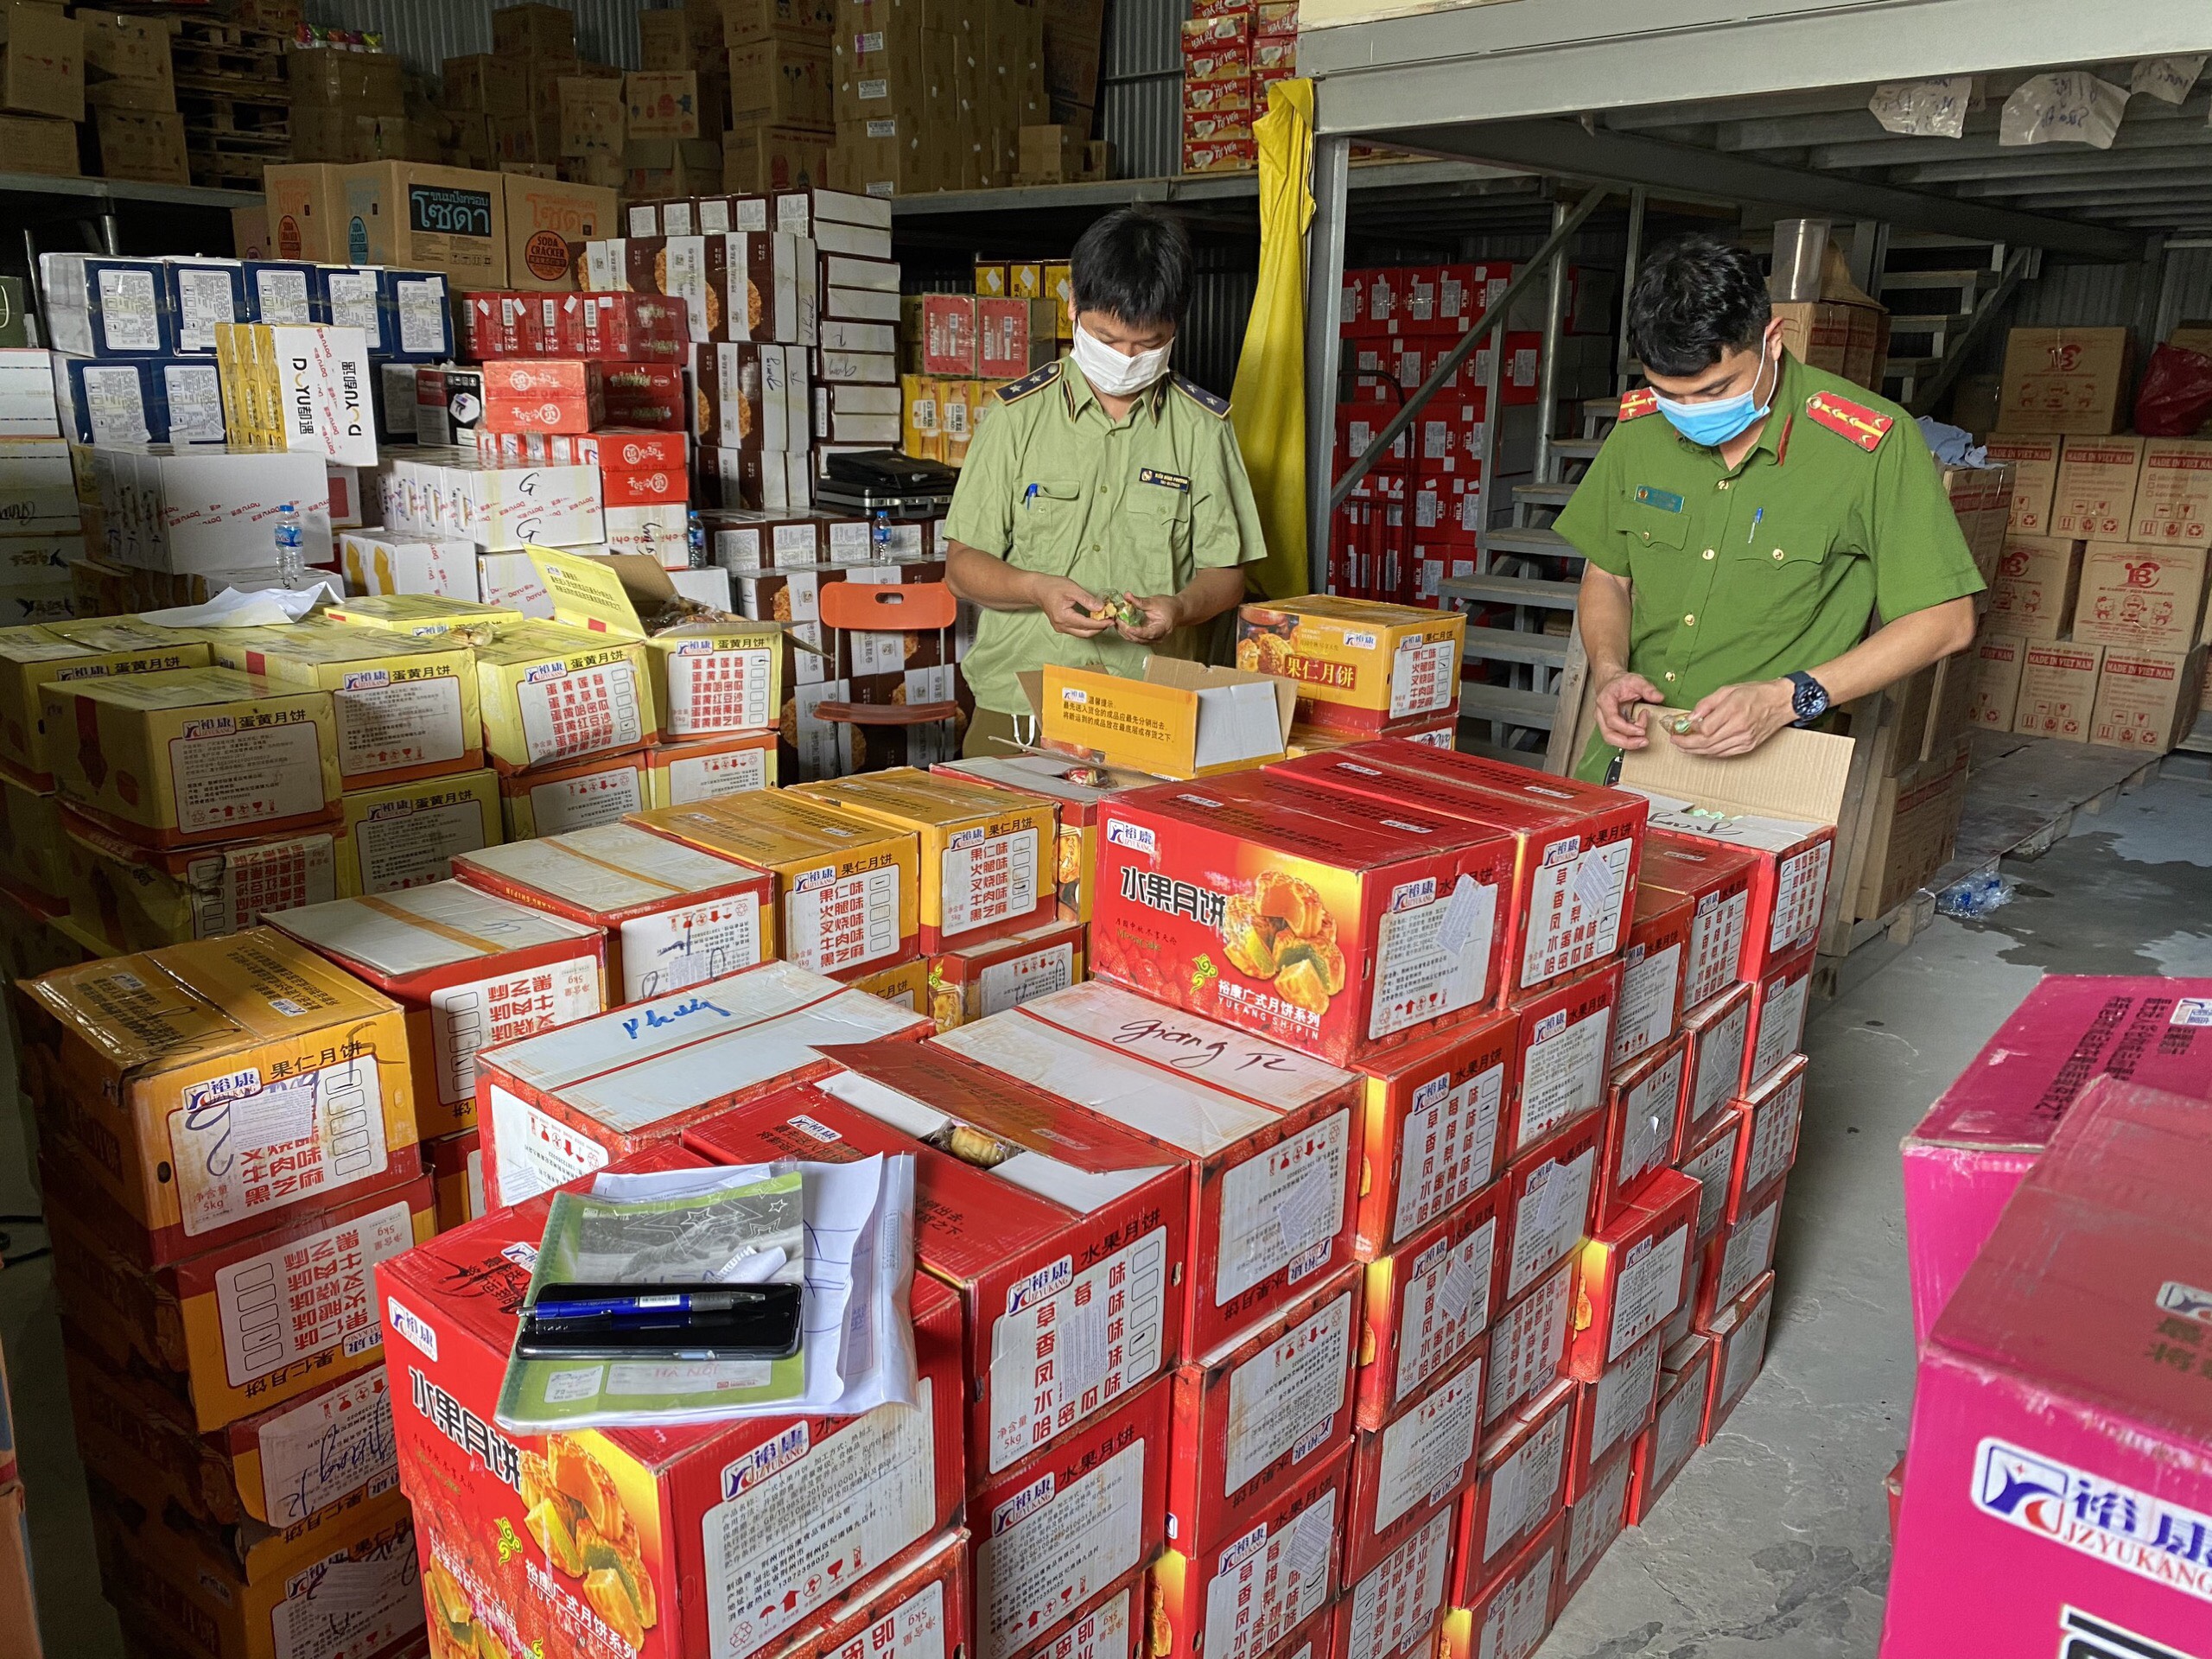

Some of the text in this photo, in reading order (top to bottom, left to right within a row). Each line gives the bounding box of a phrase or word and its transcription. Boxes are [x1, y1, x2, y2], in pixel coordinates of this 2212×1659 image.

[412, 191, 489, 234] โซดา
[279, 232, 297, 242] CRACKER
[283, 223, 294, 232] SODA
[531, 246, 564, 257] CRACKER
[537, 238, 557, 247] SODA
[2017, 450, 2050, 460] VIET NAM
[2066, 452, 2133, 463] MADE IN VIET NAM
[2151, 457, 2171, 467] MADE
[2172, 458, 2179, 467] IN
[2181, 459, 2199, 468] VIET
[718, 639, 765, 648] 蛋黄月饼
[1425, 631, 1452, 642] 果仁月饼
[115, 656, 181, 673] 蛋黄月饼
[570, 651, 624, 669] 蛋黄月饼
[1412, 660, 1435, 673] 火腿味
[1413, 648, 1436, 662] 果仁味
[2030, 654, 2093, 670] MADE VIET NAM
[392, 665, 450, 681] 蛋黄月饼
[692, 670, 743, 682] 蛋黄草莓
[1287, 656, 1354, 687] 果仁月饼
[1411, 673, 1434, 686] 叉烧味
[2107, 663, 2173, 679] MADE VIET NAM
[549, 687, 607, 709] 蛋黄草莓
[692, 681, 743, 694] 蛋黄哈密瓜
[692, 693, 743, 705] 蛋黄红豆沙
[1410, 685, 1434, 697] 牛肉味
[551, 699, 609, 721] 蛋黄哈密瓜
[1409, 697, 1433, 709] 黑芝麻
[239, 709, 306, 728] 蛋黄月饼
[554, 712, 611, 734] 蛋黄红豆沙
[691, 715, 742, 728] 蛋黄黑芝麻
[416, 790, 473, 809] 蛋黄月饼
[988, 817, 1032, 836] 果仁月饼
[1125, 826, 1152, 845] 裕康
[1585, 823, 1632, 848] 水果月饼
[970, 842, 1008, 862] 果仁味
[810, 869, 834, 881] 裕康
[842, 854, 893, 874] 果仁月饼
[970, 858, 1008, 877] 火腿味
[820, 881, 864, 903] 果仁味
[970, 873, 1008, 893] 叉烧味
[1409, 880, 1433, 897] 裕康
[820, 896, 864, 919] 火腿味
[970, 888, 1007, 906] 牛肉味
[1121, 866, 1227, 929] 水果月饼
[820, 912, 864, 935] 叉烧味
[969, 902, 1007, 922] 黑芝麻
[820, 928, 864, 950] 牛肉味
[1548, 920, 1598, 953] 水蜜桃味
[820, 944, 864, 967] 黑芝麻
[1544, 943, 1594, 975] 哈密瓜味
[487, 973, 553, 1003] 黑芝麻
[489, 994, 555, 1022] 牛肉味
[1218, 980, 1320, 1027] 裕康广式月饼系列
[1568, 994, 1606, 1021] 水果月饼
[492, 1012, 556, 1042] 叉烧味
[1218, 996, 1319, 1040] YUKANG SHIPIN
[270, 1040, 362, 1079] 果仁月饼
[1454, 1048, 1503, 1083] 水果月饼
[210, 1073, 255, 1093] 裕康
[1427, 1085, 1479, 1129] 草莓味
[1425, 1109, 1476, 1153] 香橙味
[242, 1147, 322, 1184] 牛肉味
[1422, 1132, 1474, 1179] 凤梨味
[245, 1166, 325, 1207] 黑芝麻
[1421, 1154, 1471, 1200] 水蜜桃味
[194, 1187, 228, 1203] 净含量
[203, 1199, 225, 1211] 5kg
[1416, 1177, 1469, 1225] 哈密瓜味
[374, 1233, 403, 1250] 净含量
[378, 1227, 395, 1236] 5kg
[1081, 1211, 1160, 1268] 水果月饼
[284, 1230, 359, 1272] 黑芝麻
[288, 1252, 362, 1292] 牛肉味
[1033, 1261, 1069, 1291] 裕康
[289, 1269, 364, 1312] 叉烧味
[1030, 1279, 1069, 1302] JZYUKANG
[1037, 1261, 1126, 1330] 草莓味
[1224, 1270, 1286, 1321] 水果月饼
[292, 1289, 366, 1332] 火腿味
[295, 1311, 368, 1351] 果仁味
[1036, 1291, 1125, 1360] 香味
[1035, 1318, 1123, 1389] 凤味
[1418, 1328, 1465, 1382] 哈密瓜味
[245, 1351, 334, 1398] 果仁月饼
[1033, 1372, 1122, 1444] 哈密瓜味
[409, 1365, 522, 1495] 水果月饼
[997, 1415, 1027, 1439] 净含量
[754, 1427, 804, 1468] 裕康
[1004, 1433, 1021, 1449] 5kg
[753, 1447, 804, 1484] JZYUKANG
[1059, 1425, 1134, 1486] 水果月饼
[1016, 1478, 1051, 1510] 裕康
[1233, 1457, 1290, 1509] 水果月饼
[1014, 1492, 1051, 1521] JZYUKANG
[1274, 1475, 1332, 1528] 水果月饼
[1236, 1570, 1300, 1630] 凤梨味
